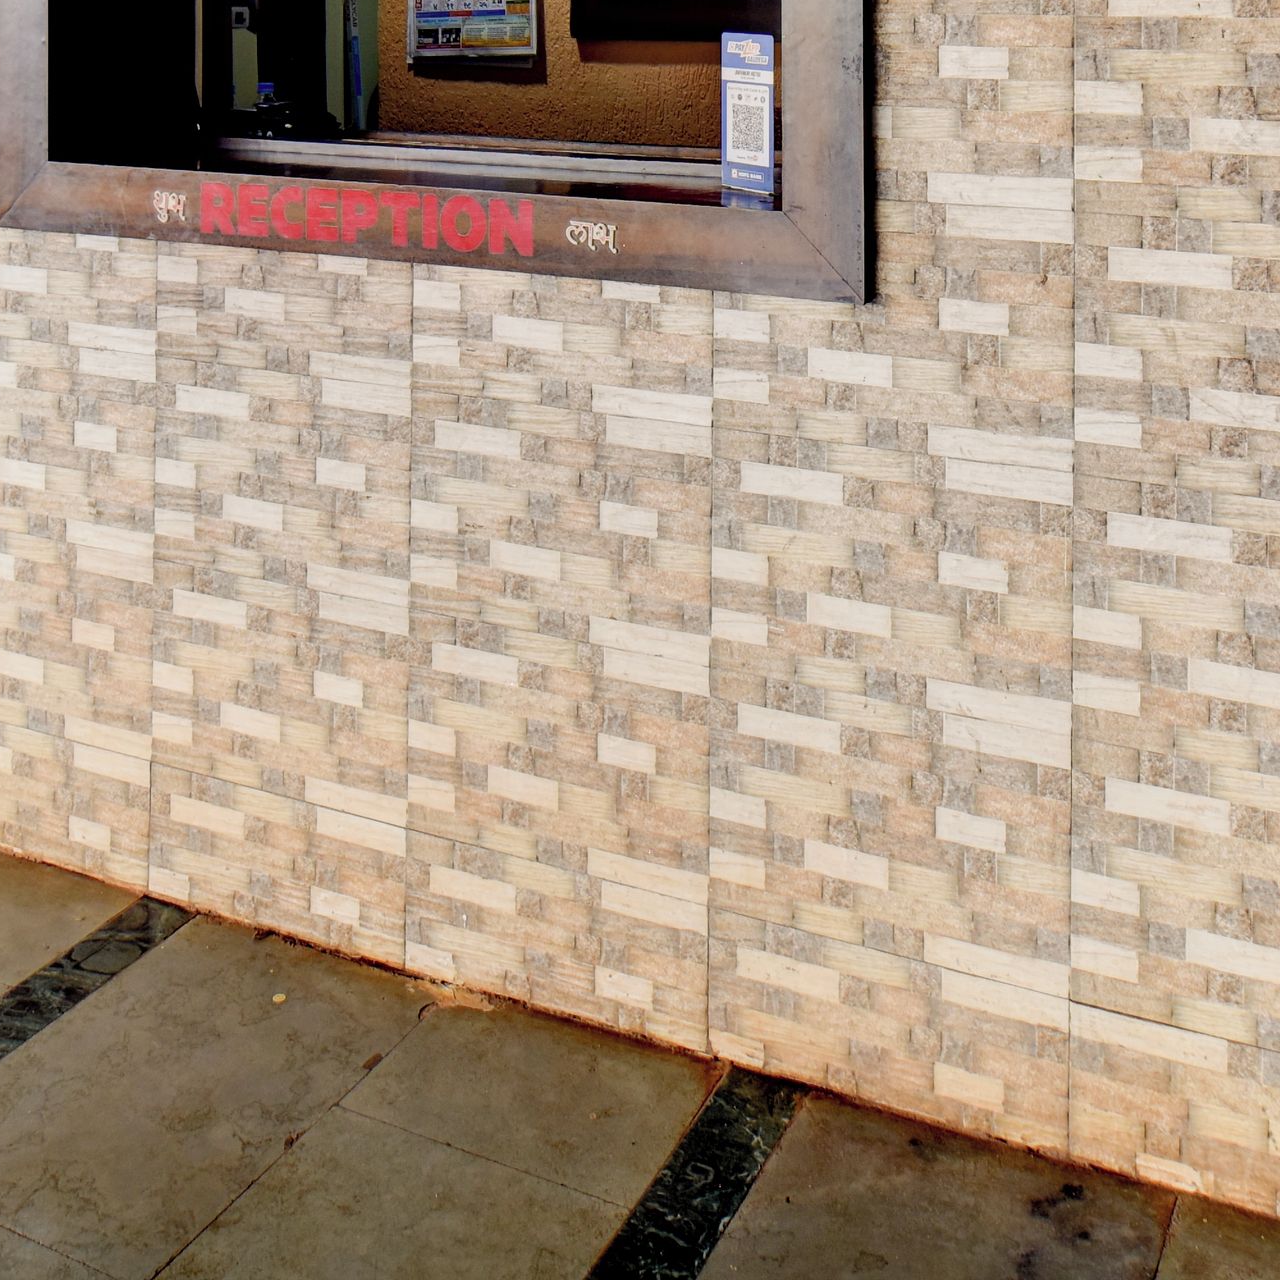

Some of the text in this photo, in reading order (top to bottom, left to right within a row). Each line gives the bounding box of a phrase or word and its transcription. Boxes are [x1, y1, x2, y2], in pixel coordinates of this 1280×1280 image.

[153, 190, 186, 223] शुभ
[200, 182, 535, 257] RECEPTION
[565, 220, 618, 254] लाभ
